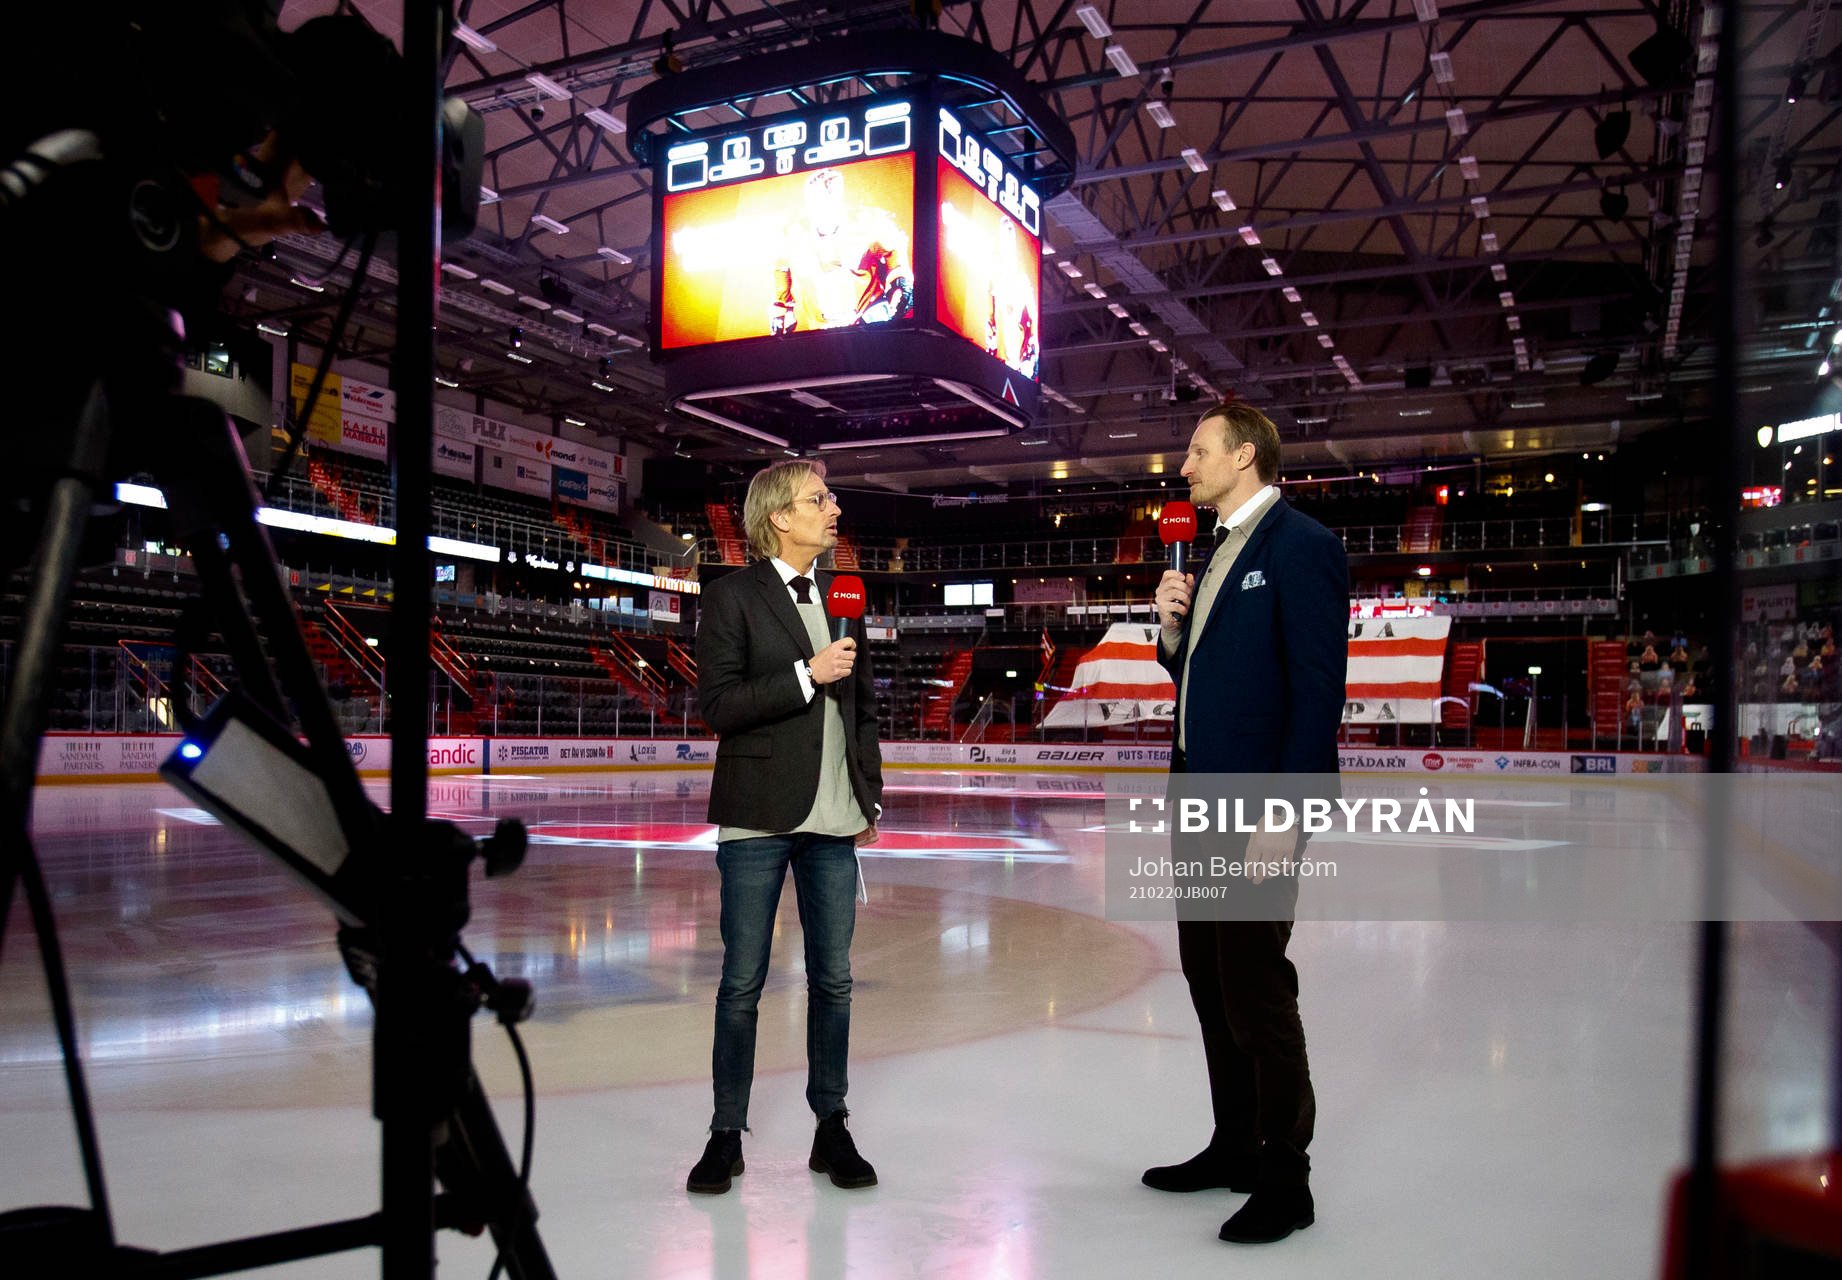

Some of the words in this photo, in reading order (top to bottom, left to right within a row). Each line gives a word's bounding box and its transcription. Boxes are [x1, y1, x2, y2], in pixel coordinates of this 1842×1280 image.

[343, 420, 385, 436] KAKEL
[472, 416, 507, 441] FLEX
[550, 450, 576, 463] mondi
[427, 743, 476, 765] andic
[511, 746, 549, 756] PISCATOR
[560, 748, 571, 759] DET
[580, 748, 586, 758] VI
[586, 748, 598, 758] SOM
[637, 743, 657, 755] Loxia
[1037, 750, 1105, 761] BAUER
[1117, 750, 1143, 761] PUTS
[63, 760, 105, 770] PARTNERS
[1513, 759, 1561, 770] INFRA-CON
[1585, 758, 1614, 771] BRL
